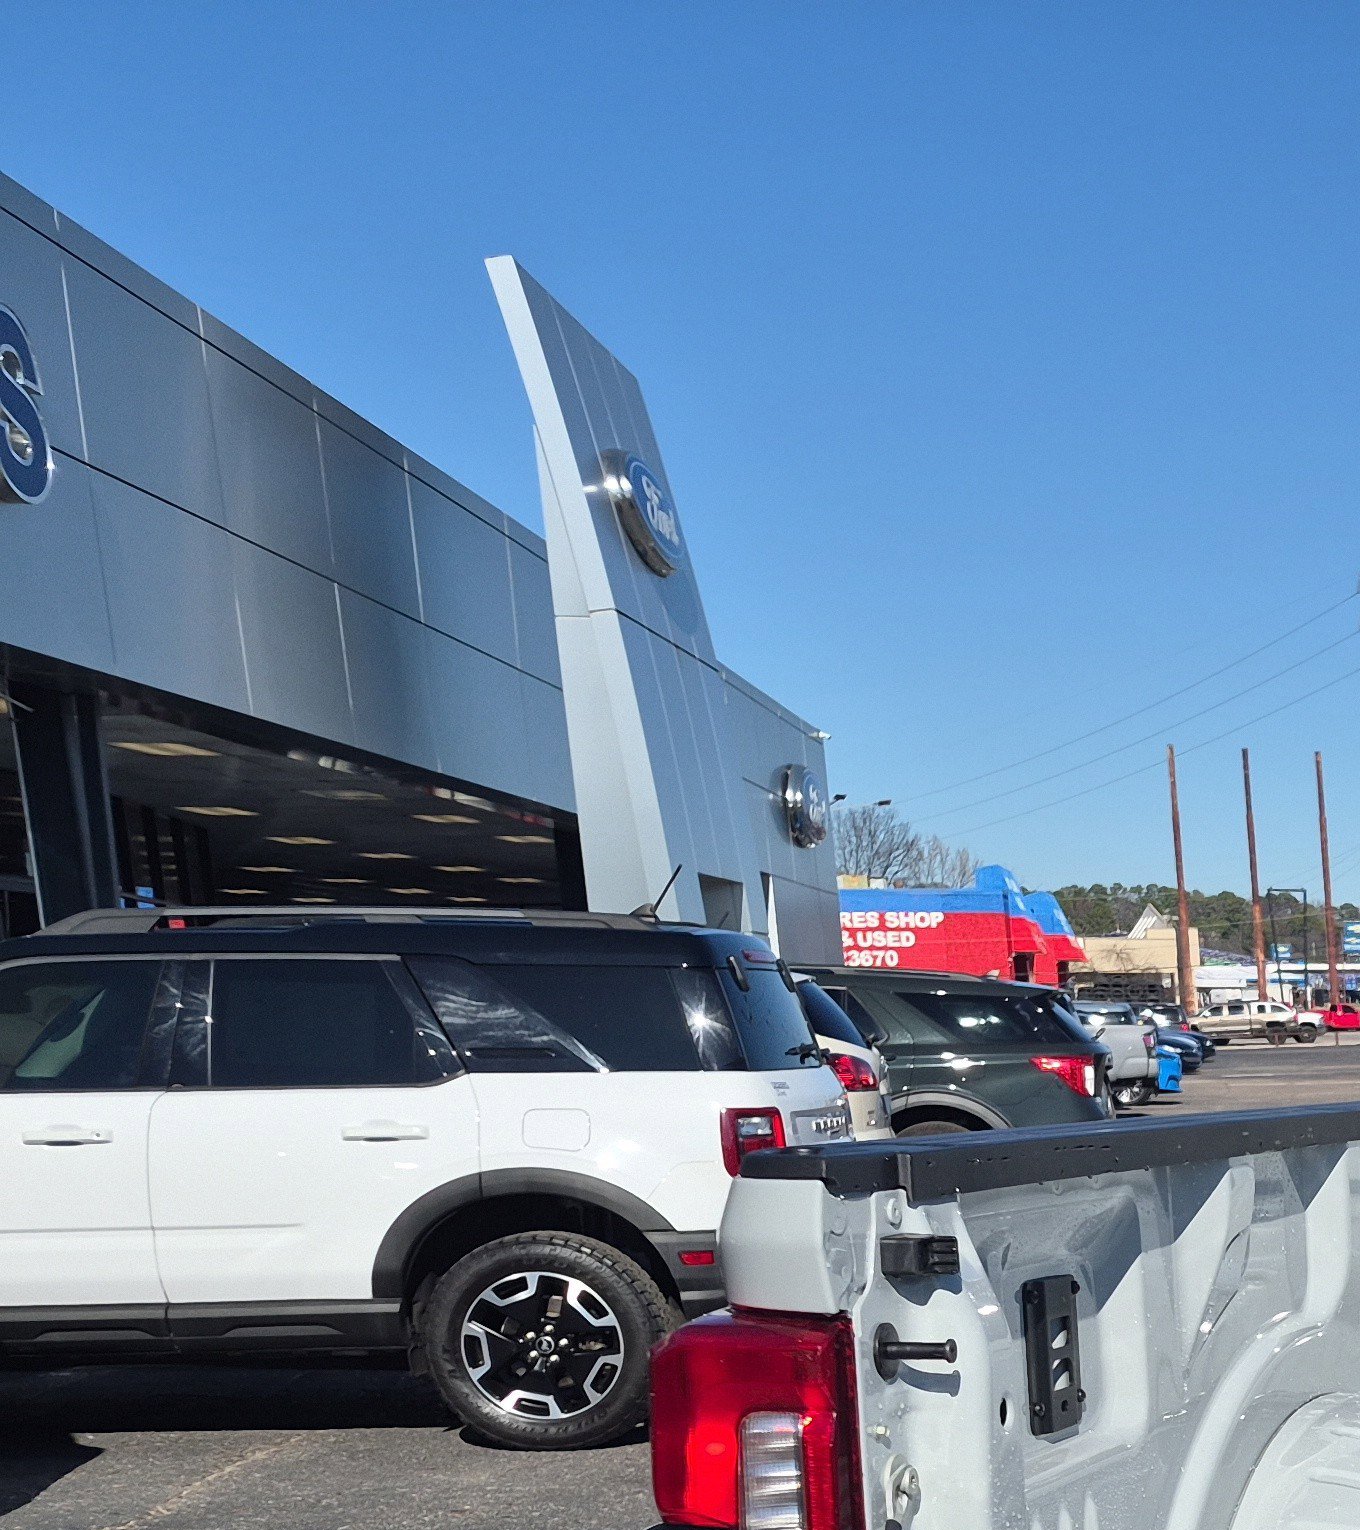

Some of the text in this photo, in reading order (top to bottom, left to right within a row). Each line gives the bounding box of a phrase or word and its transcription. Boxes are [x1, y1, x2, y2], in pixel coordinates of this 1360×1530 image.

[884, 911, 944, 928] SHOP
[856, 930, 915, 947] USED
[843, 949, 899, 967] 3670
